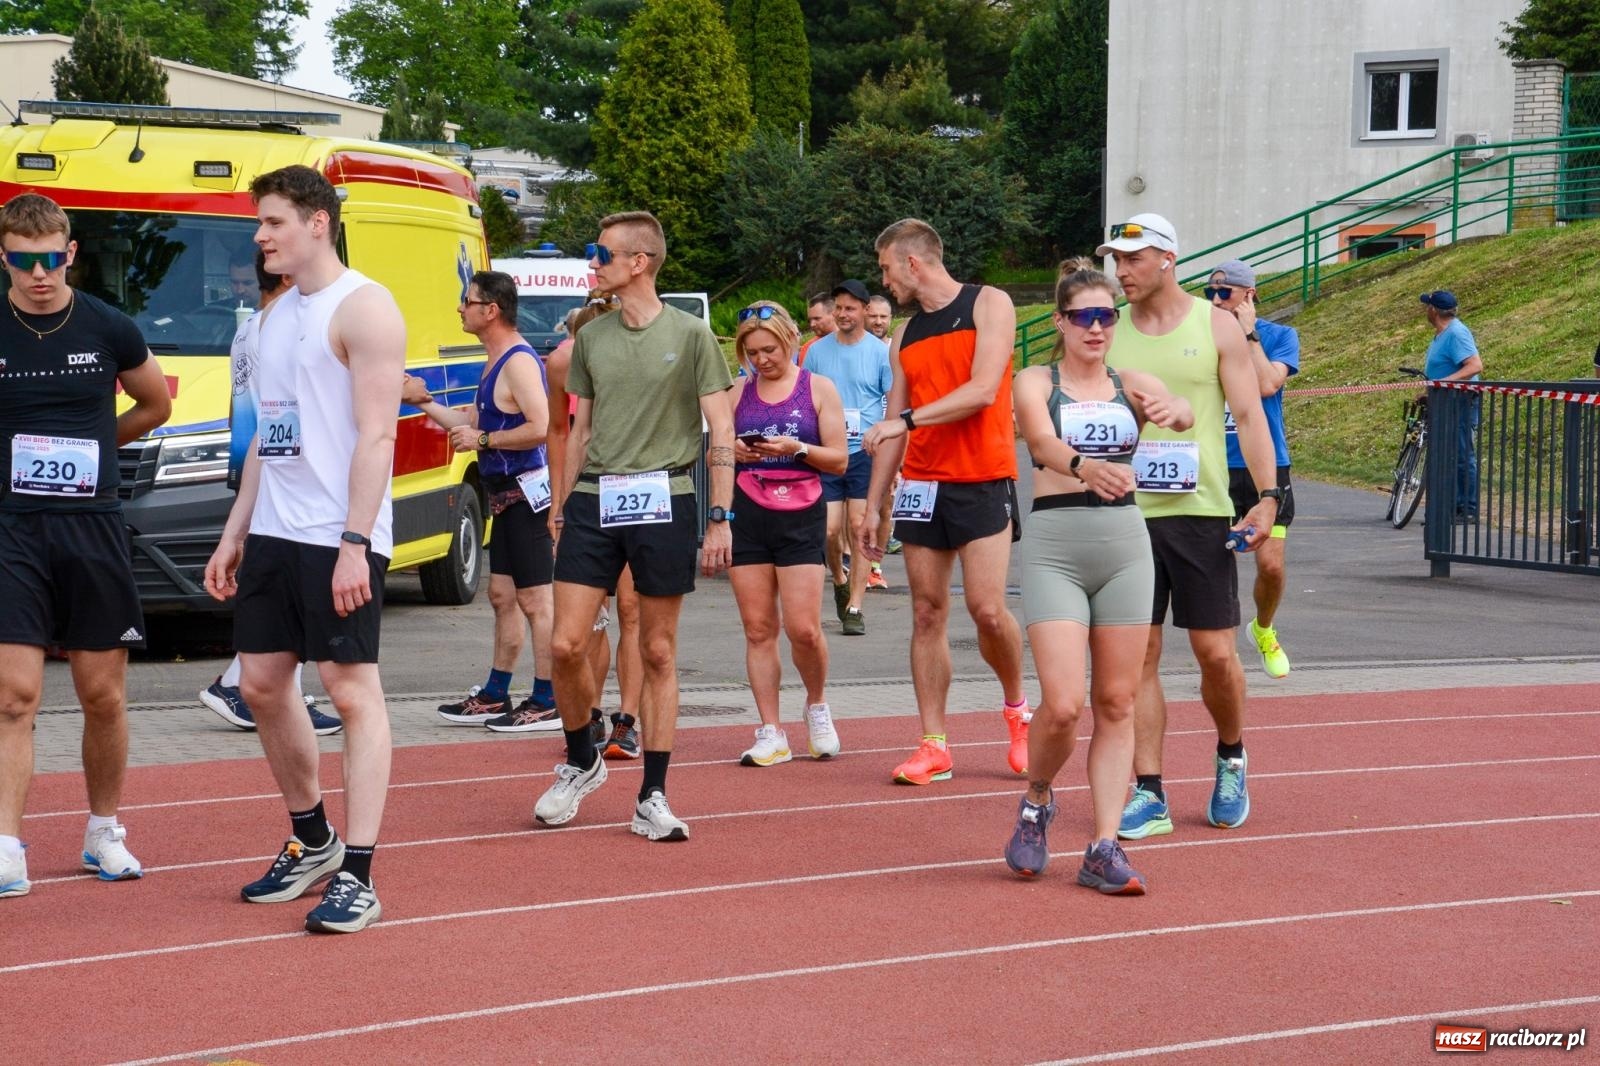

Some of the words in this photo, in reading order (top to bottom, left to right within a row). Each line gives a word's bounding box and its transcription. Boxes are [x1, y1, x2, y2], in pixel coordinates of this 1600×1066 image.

[67, 353, 98, 365] DZIK
[33, 436, 50, 444] BIEG
[65, 439, 93, 447] GRANIC
[268, 423, 294, 444] 204
[1084, 423, 1117, 442] 231
[31, 459, 77, 481] 230
[1147, 461, 1179, 479] 213
[616, 492, 652, 512] 237
[899, 493, 922, 509] 215
